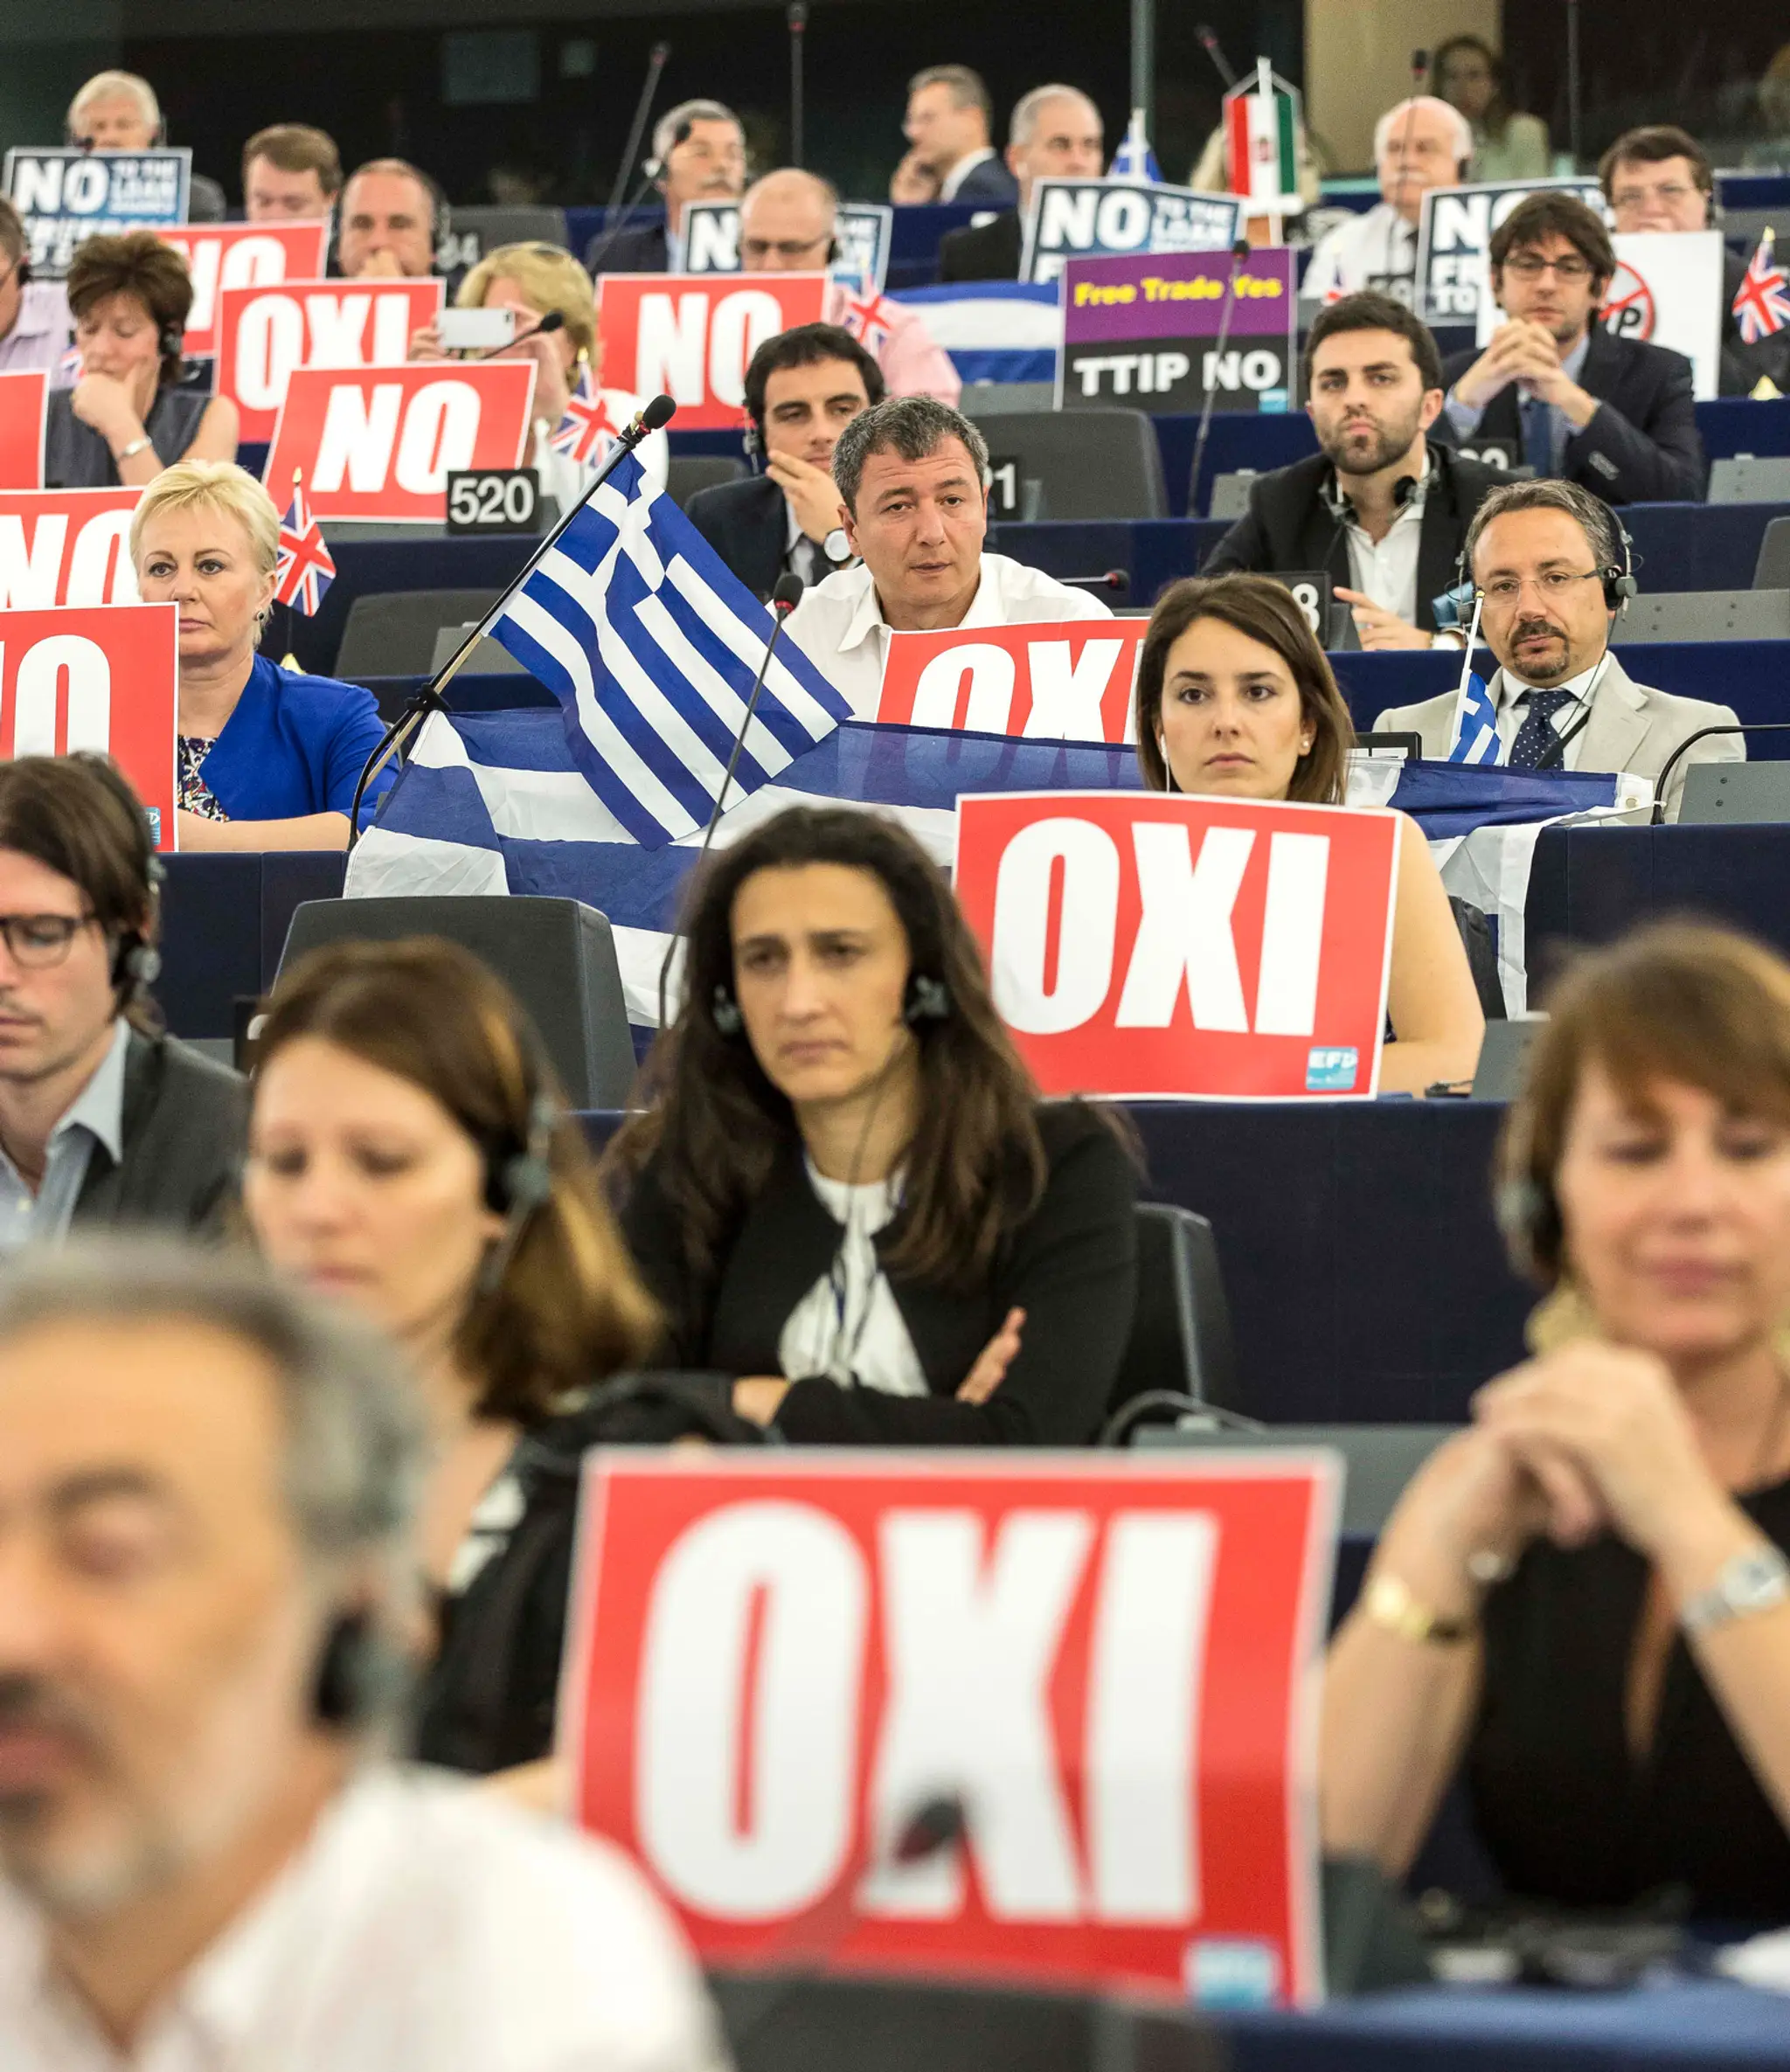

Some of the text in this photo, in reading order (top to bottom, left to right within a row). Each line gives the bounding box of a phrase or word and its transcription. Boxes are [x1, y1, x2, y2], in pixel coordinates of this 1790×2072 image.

[15, 157, 110, 214] NO
[1039, 188, 1151, 250] NO
[688, 211, 741, 271] N
[1074, 274, 1283, 307] Free Trade Yes
[235, 294, 411, 411] OXI
[635, 289, 782, 407] NO
[1072, 350, 1282, 396] TTIP NO
[310, 380, 482, 495] NO
[450, 476, 535, 523] 520
[0, 509, 142, 607] NO
[0, 634, 111, 762] O
[992, 816, 1330, 1036] OXI
[635, 1499, 1218, 1923] OXI
